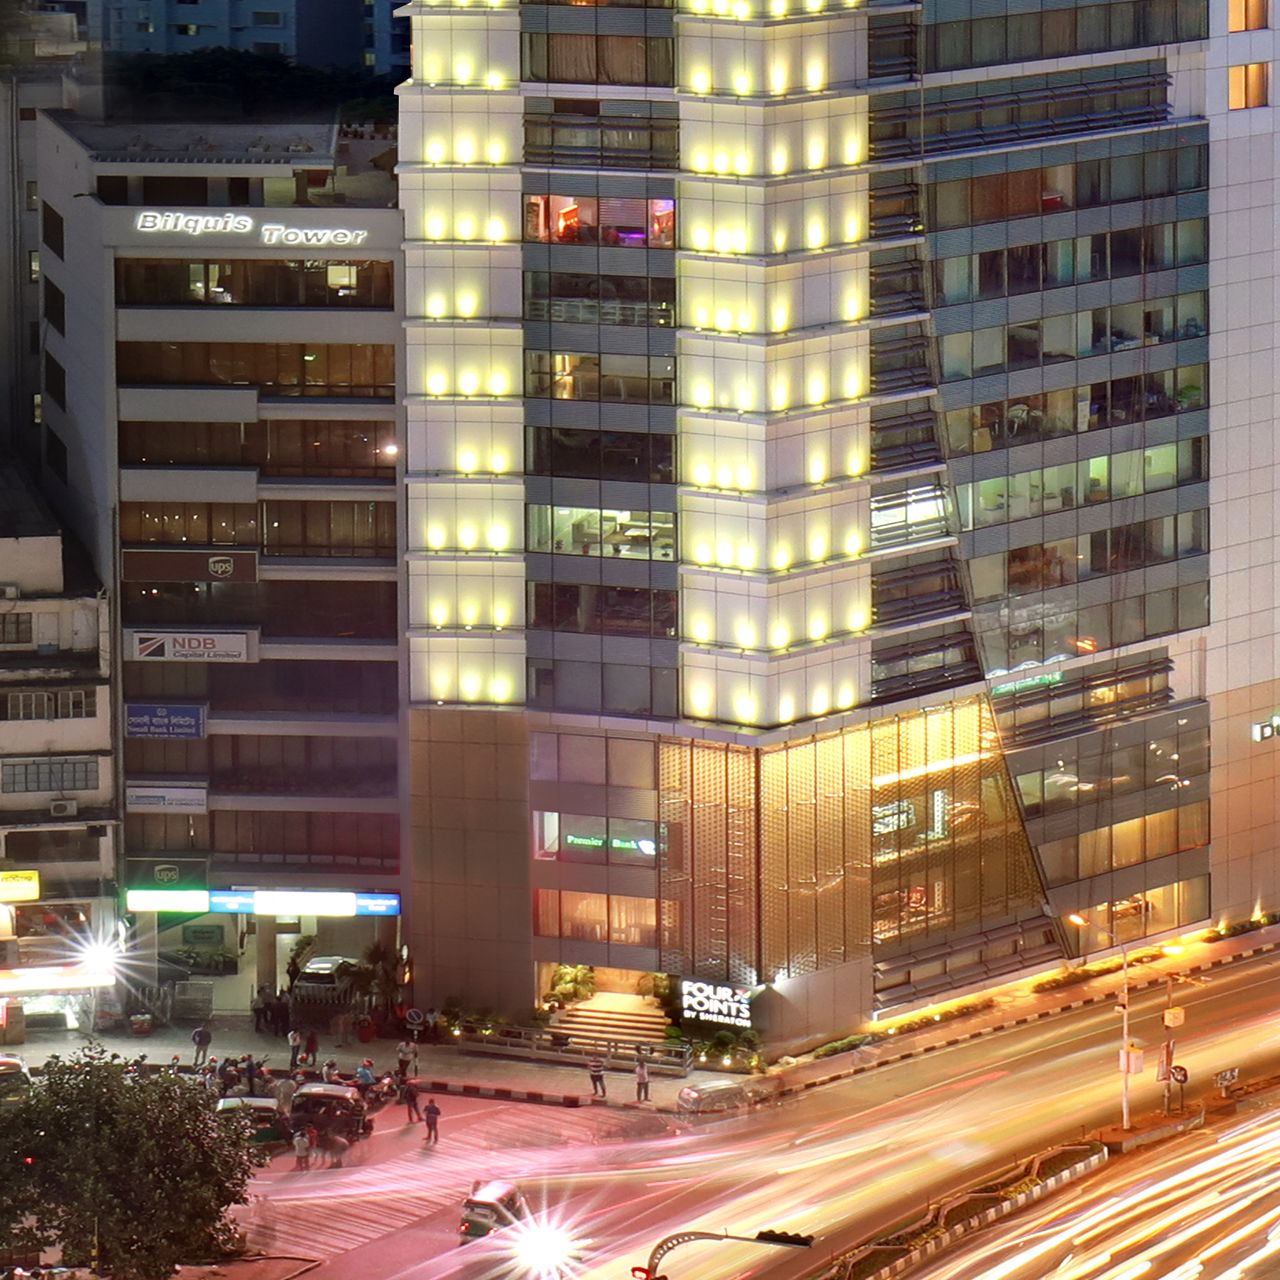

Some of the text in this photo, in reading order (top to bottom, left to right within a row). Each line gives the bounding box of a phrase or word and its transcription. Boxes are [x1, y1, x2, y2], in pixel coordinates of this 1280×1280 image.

[137, 211, 368, 245] Bilquis Tower
[210, 562, 232, 574] ups
[172, 638, 217, 650] NDB
[173, 651, 242, 659] Capital Limited
[156, 869, 177, 883] ups
[682, 980, 734, 1002] FOUR
[683, 994, 751, 1019] POINTS
